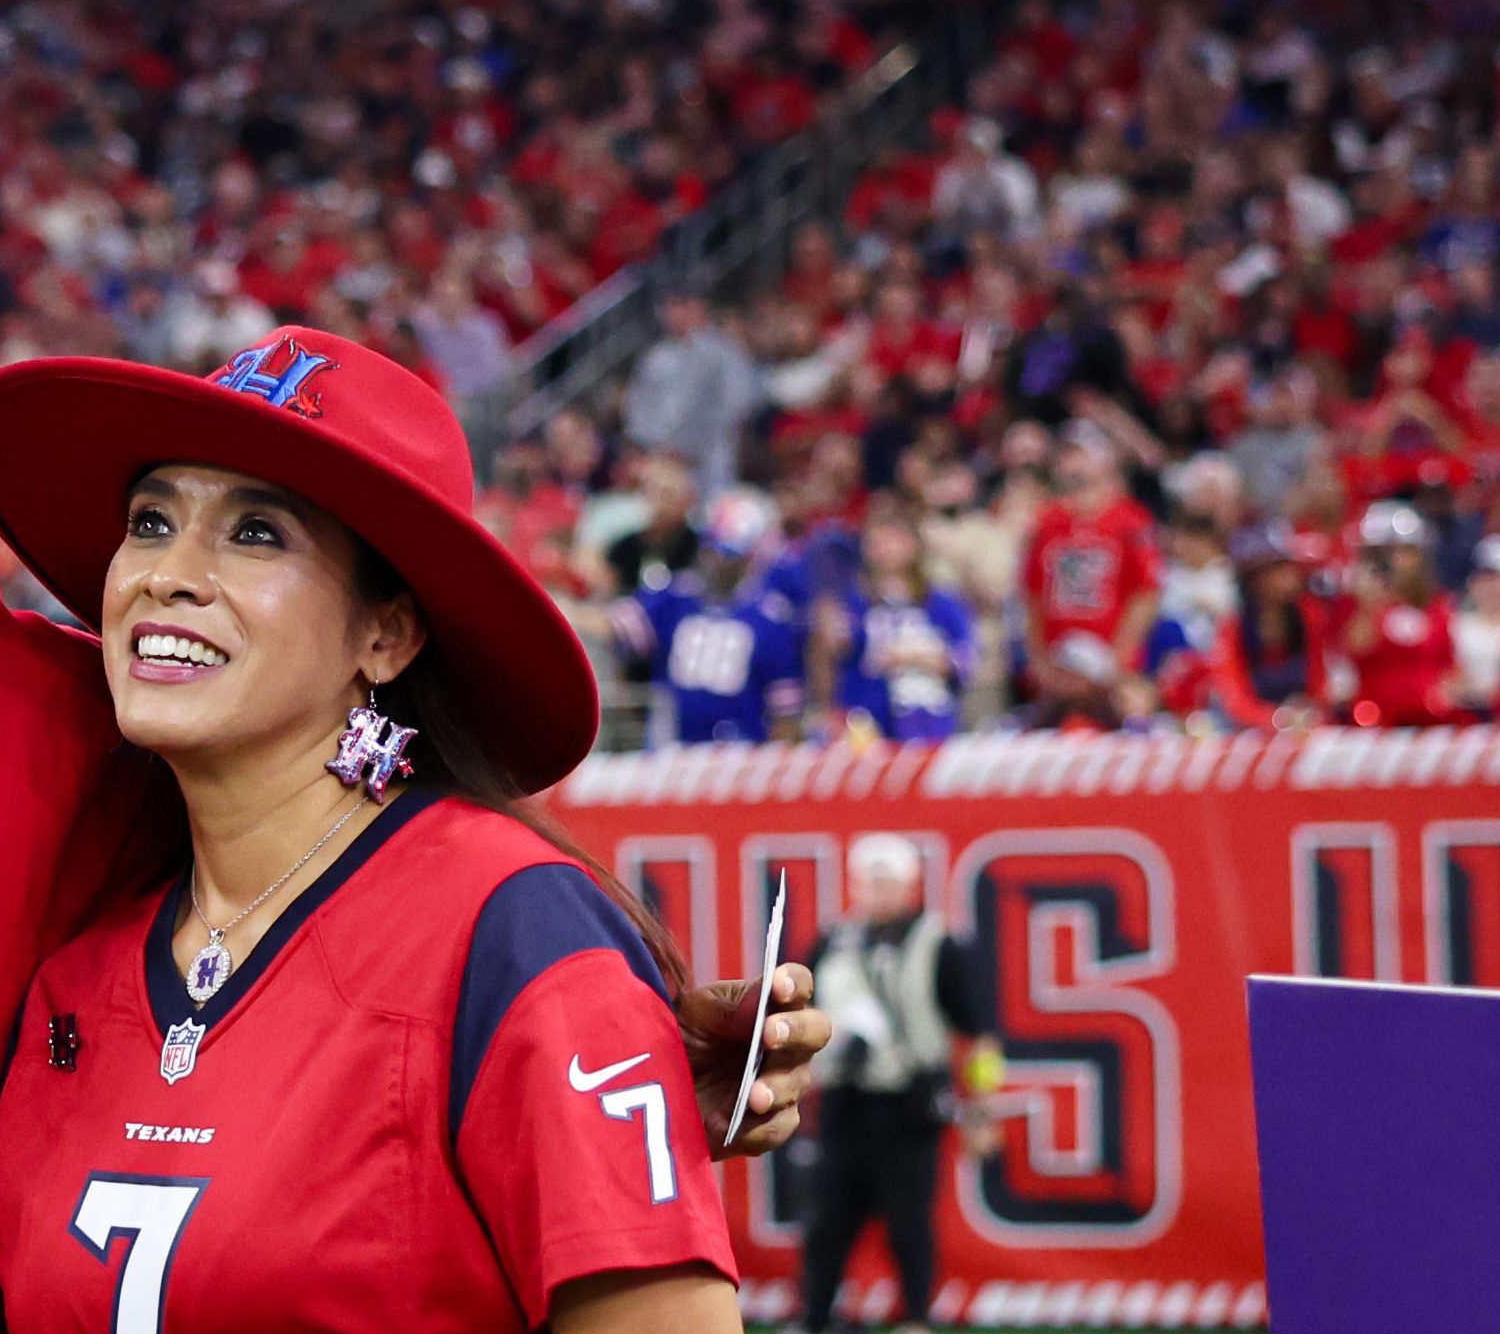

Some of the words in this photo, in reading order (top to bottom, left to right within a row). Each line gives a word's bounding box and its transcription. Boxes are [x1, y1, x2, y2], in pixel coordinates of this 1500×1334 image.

[164, 1046, 188, 1071] NFL
[124, 1122, 216, 1145] TEXANS
[599, 1082, 677, 1204] 7
